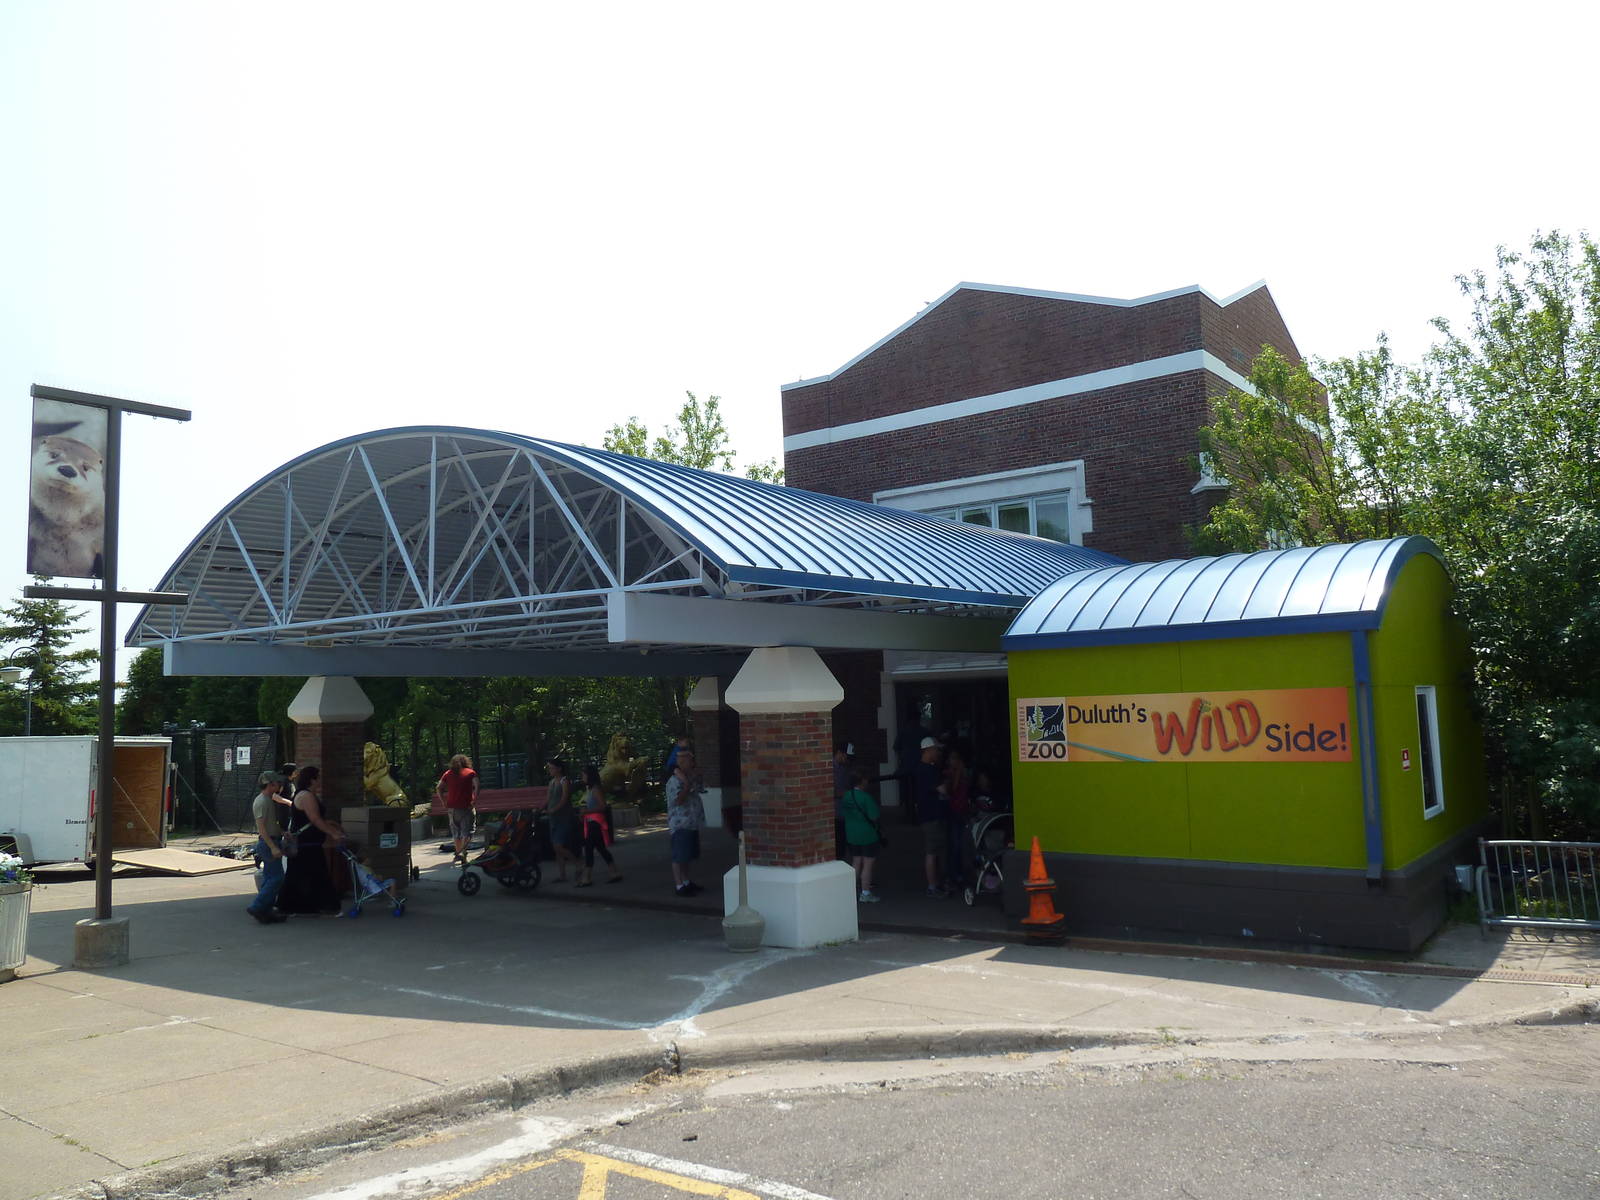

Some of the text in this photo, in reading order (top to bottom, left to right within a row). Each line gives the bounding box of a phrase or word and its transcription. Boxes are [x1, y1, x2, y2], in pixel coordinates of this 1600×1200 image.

[1068, 702, 1148, 725] Duluth's
[1264, 723, 1347, 753] Side!
[1028, 742, 1067, 759] ZOO
